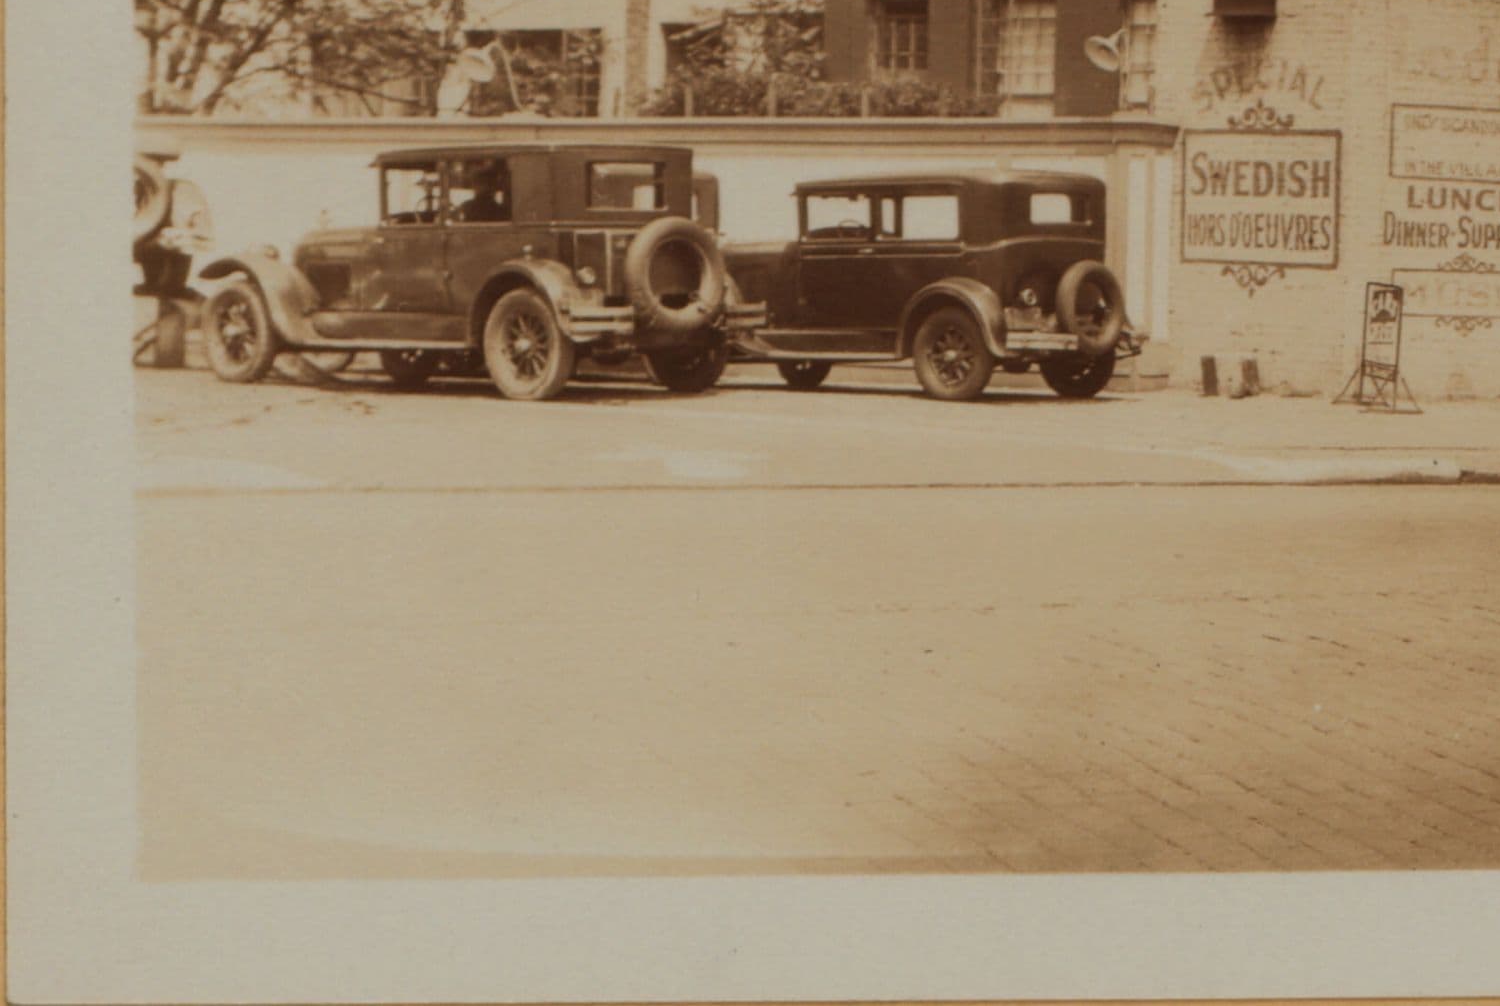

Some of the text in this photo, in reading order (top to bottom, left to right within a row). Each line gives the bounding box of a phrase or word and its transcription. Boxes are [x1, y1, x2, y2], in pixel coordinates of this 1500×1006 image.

[1192, 58, 1325, 114] SPECIAL
[1190, 151, 1331, 199] SWEDISH
[1187, 213, 1226, 247] HORS
